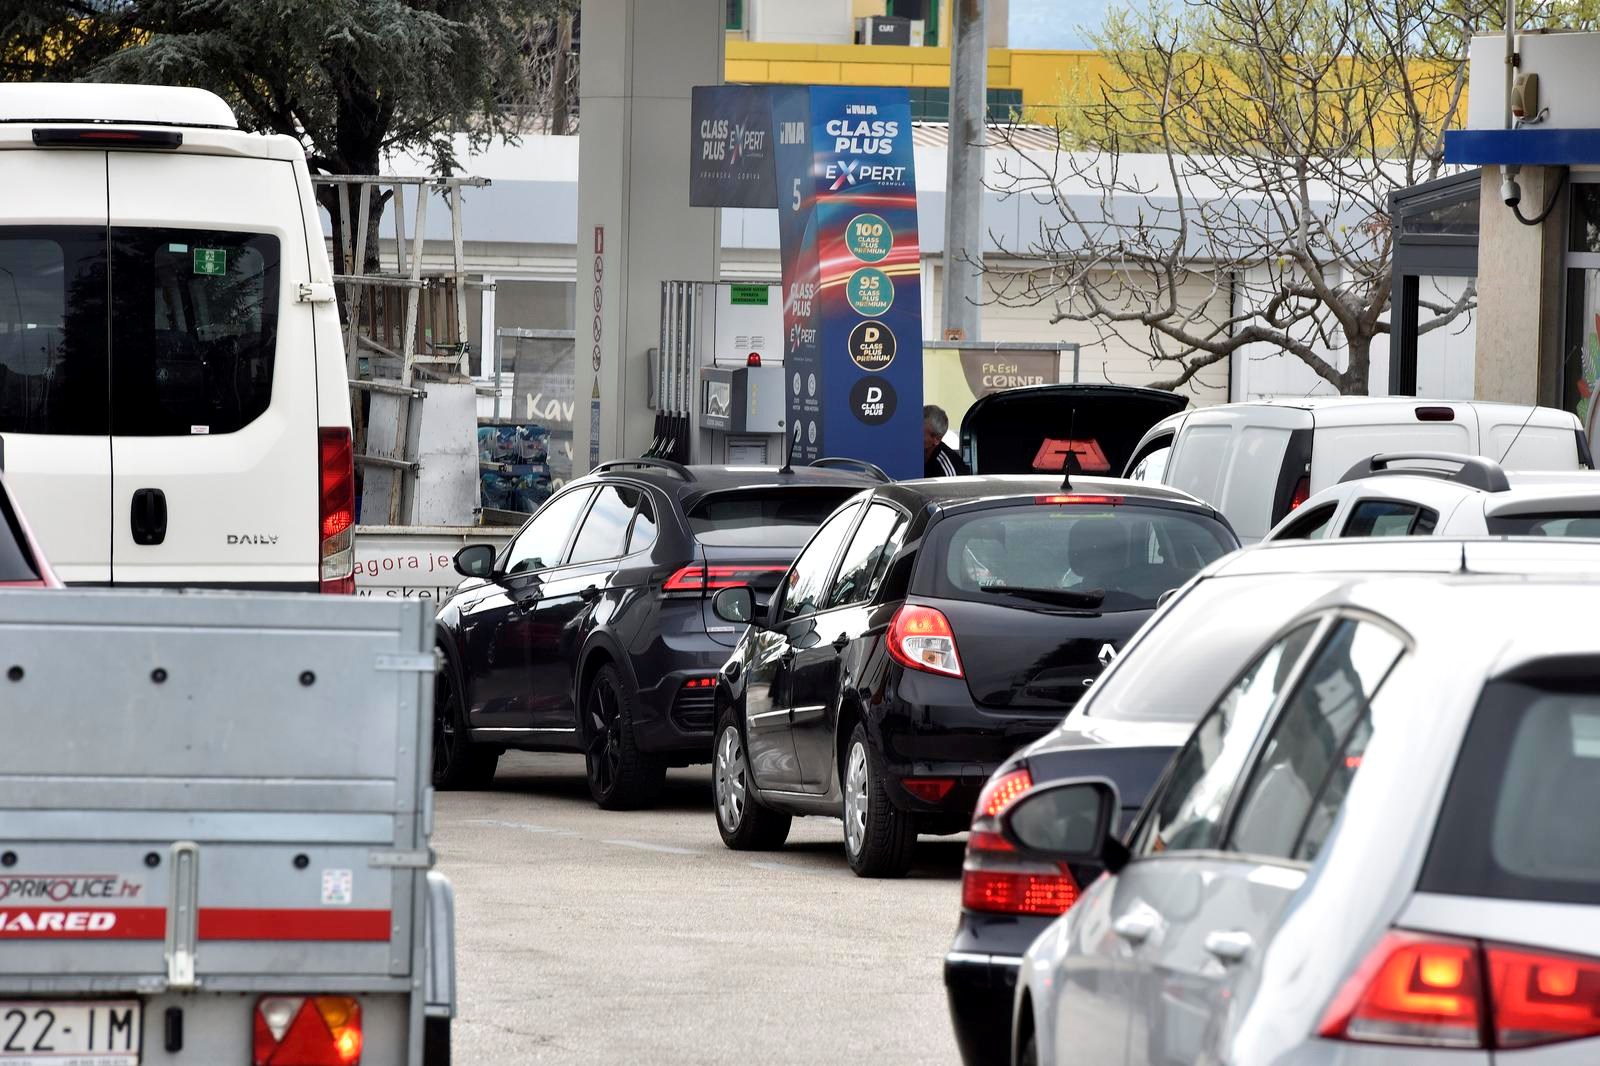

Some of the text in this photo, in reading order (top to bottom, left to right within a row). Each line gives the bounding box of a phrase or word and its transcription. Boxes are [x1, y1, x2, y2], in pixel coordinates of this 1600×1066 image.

[700, 120, 728, 139] CLASS
[826, 120, 898, 137] CLASS
[702, 141, 725, 160] PLUS
[730, 122, 765, 164] EXPERT
[835, 137, 893, 154] PLUS
[825, 158, 906, 191] EXPERT
[792, 178, 801, 211] 5
[855, 223, 883, 236] 100
[853, 247, 886, 255] PREMIUM
[790, 282, 814, 300] CLASS
[860, 276, 880, 289] 95
[792, 300, 811, 317] PLUS
[855, 300, 887, 308] PREMIUM
[790, 323, 816, 352] EXPERT
[864, 327, 880, 342] D
[860, 343, 883, 351] CLASS
[856, 354, 891, 362] PREMIUM
[982, 363, 1018, 374] FRESH
[866, 386, 882, 403] D
[227, 534, 279, 545] DAILY
[428, 552, 450, 573] je
